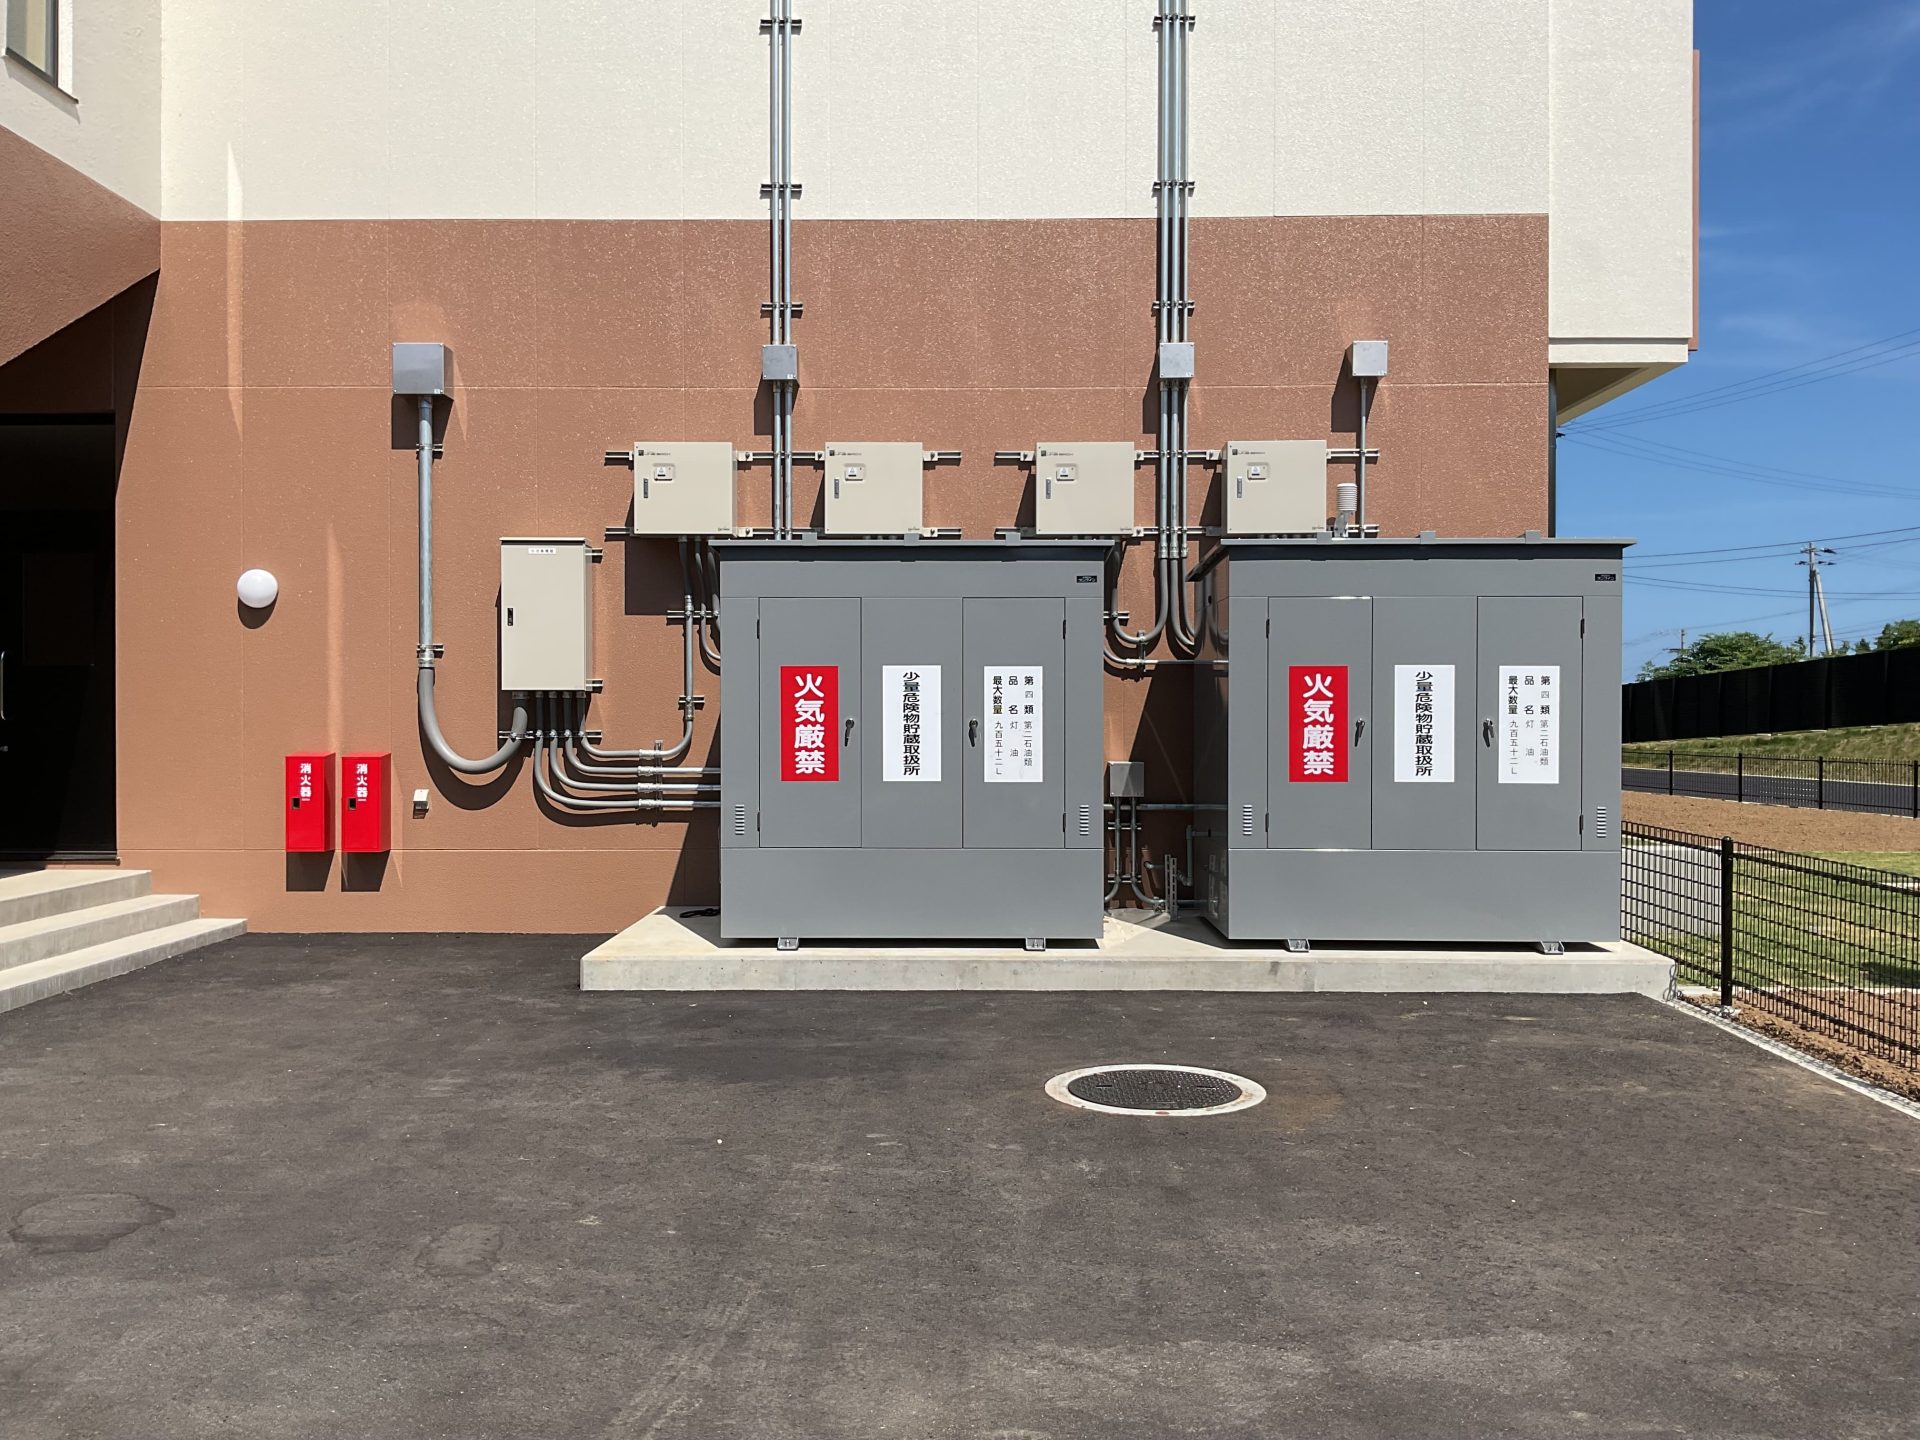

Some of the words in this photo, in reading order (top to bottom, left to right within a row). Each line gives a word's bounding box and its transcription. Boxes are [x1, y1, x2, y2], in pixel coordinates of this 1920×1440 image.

[794, 674, 825, 774] 火気厳禁
[903, 672, 920, 775] 少量危険物貯蔵取扱所
[1303, 674, 1334, 774] 火気厳禁
[1415, 671, 1433, 776] 少量危険物貯蔵取扱所
